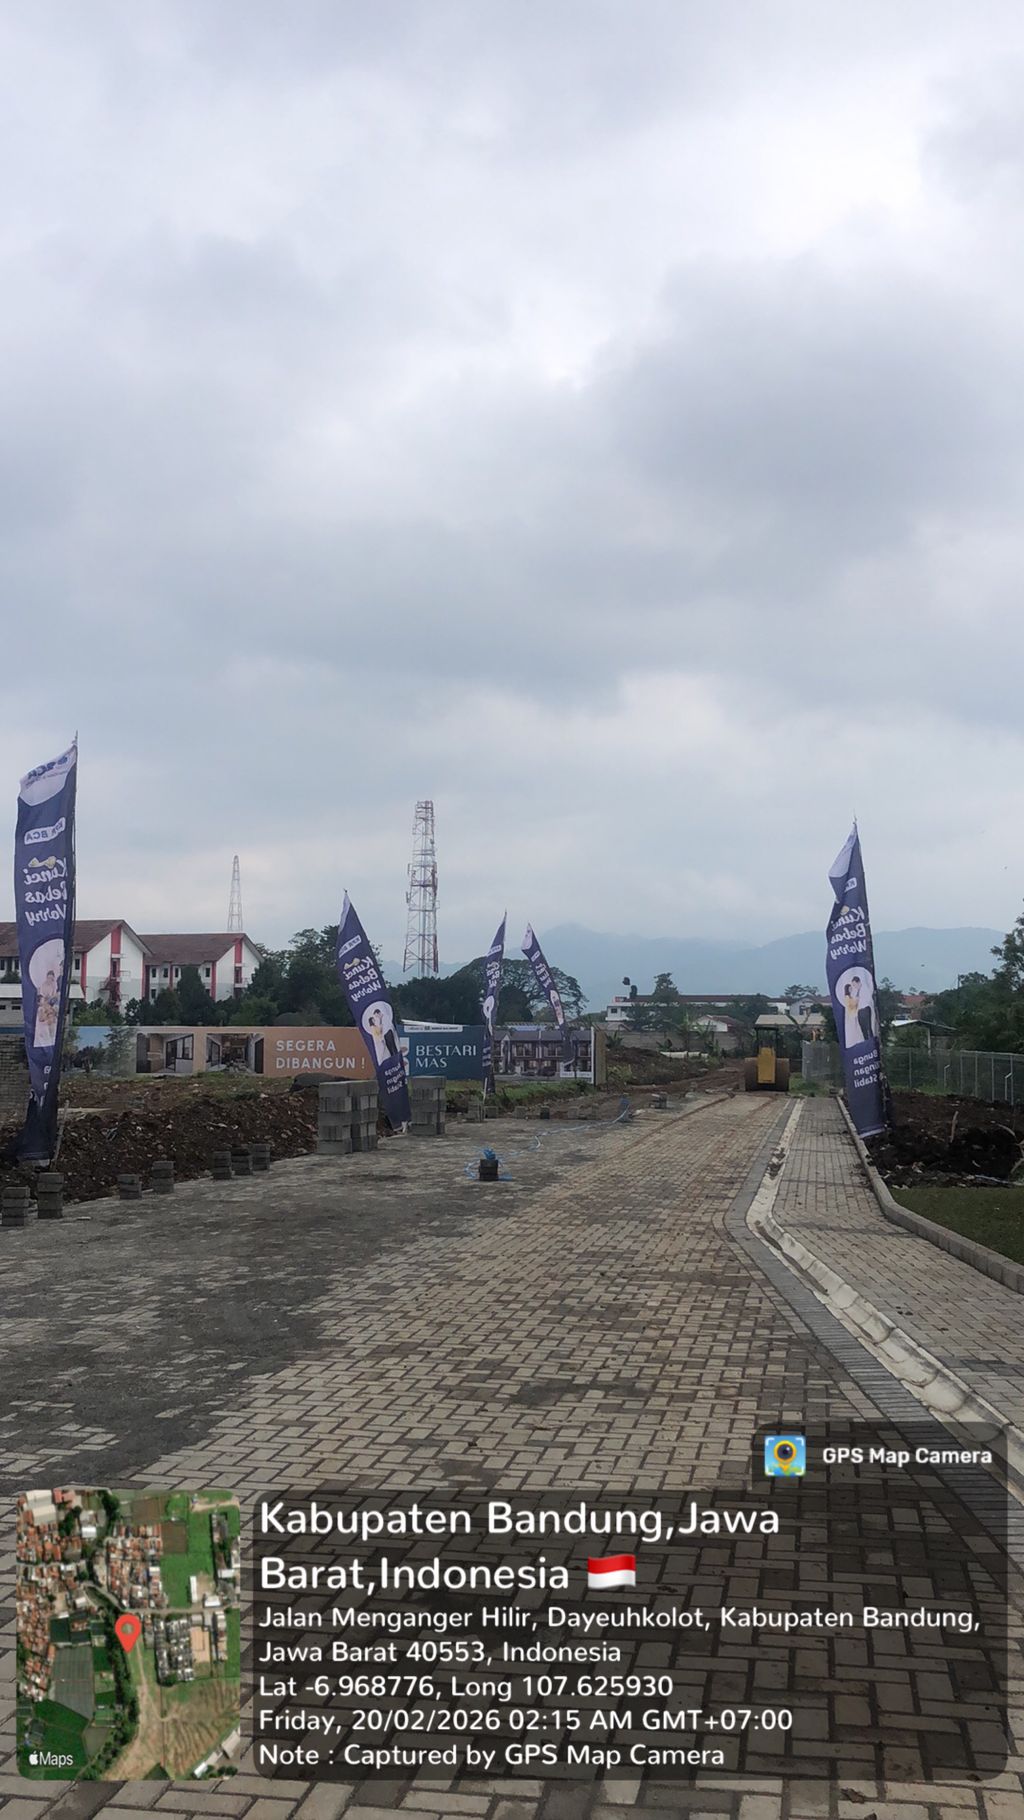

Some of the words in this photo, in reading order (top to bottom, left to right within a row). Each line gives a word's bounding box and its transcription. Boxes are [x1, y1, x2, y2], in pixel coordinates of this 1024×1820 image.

[276, 1040, 336, 1051] SEGERA
[415, 1045, 476, 1056] BESTARI
[276, 1057, 355, 1069] DIBANGUN
[415, 1058, 447, 1068] MAS
